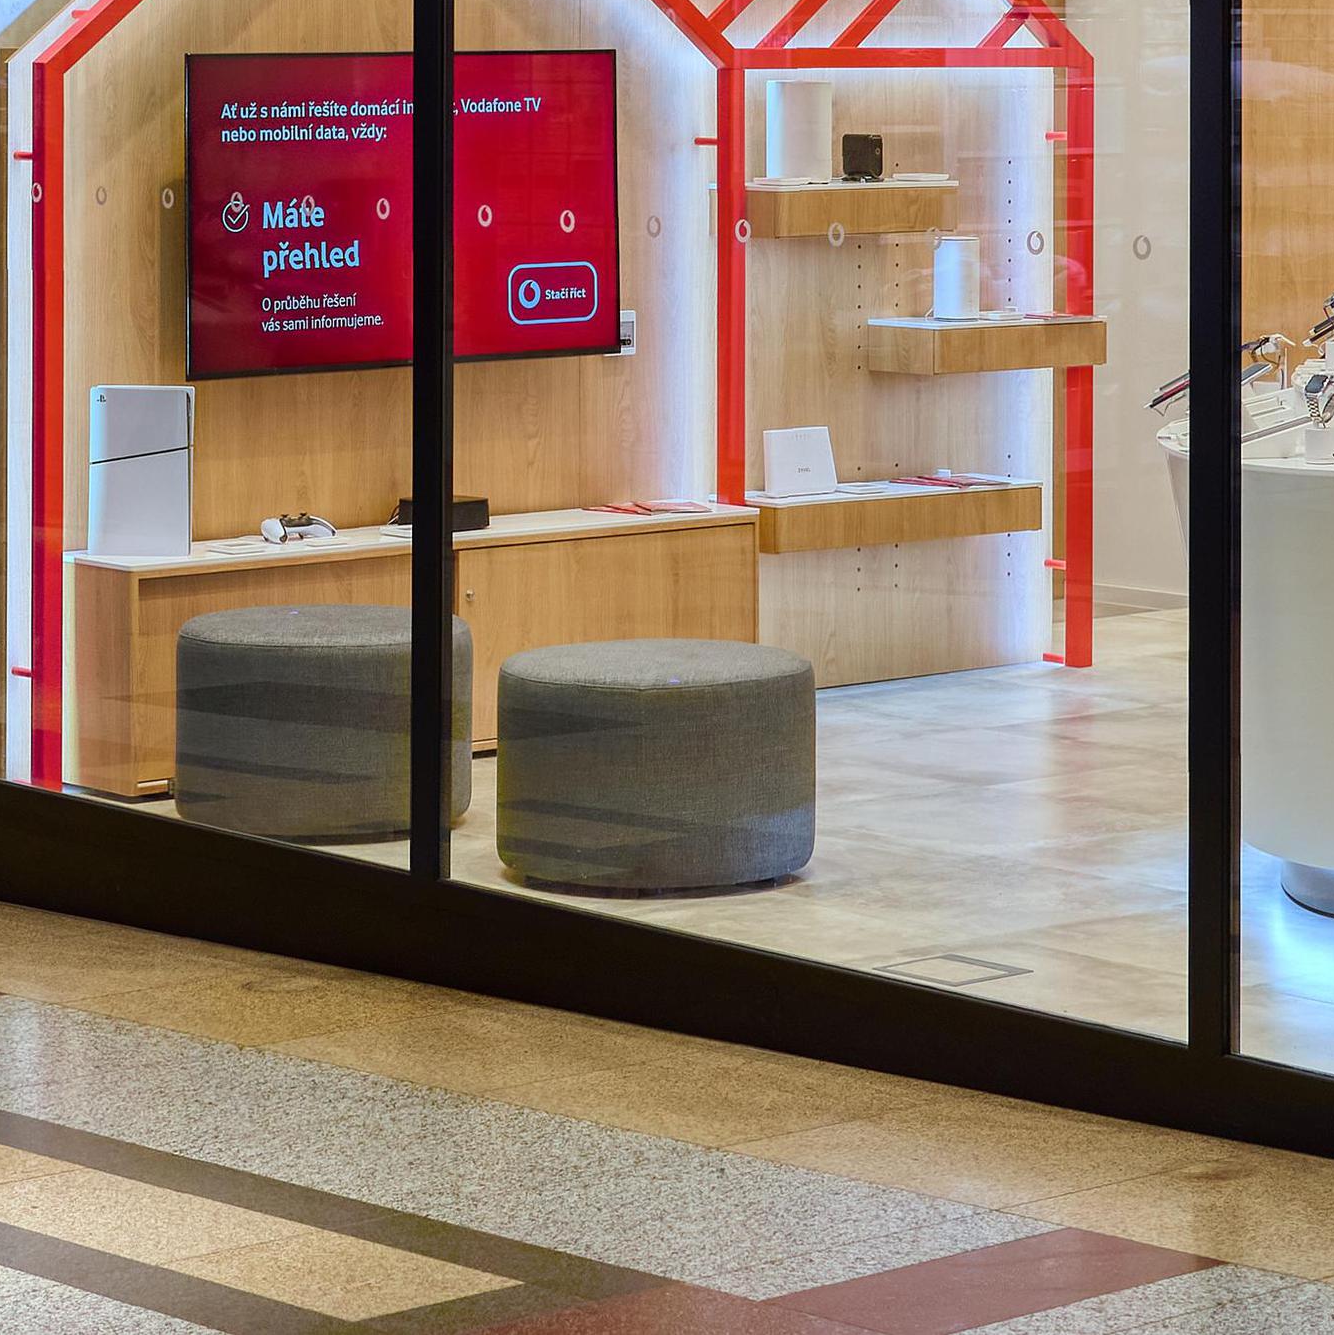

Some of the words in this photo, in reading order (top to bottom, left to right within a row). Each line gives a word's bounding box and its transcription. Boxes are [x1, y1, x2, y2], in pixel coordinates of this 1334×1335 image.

[221, 102, 237, 119] Ať
[240, 102, 257, 119] už
[260, 106, 268, 118] s
[271, 101, 306, 118] námi
[308, 100, 348, 118] řešíte
[350, 99, 401, 116] domácí
[460, 97, 522, 113] Vodafone
[523, 97, 542, 112] TV
[221, 126, 257, 142] nebo
[259, 124, 312, 141] mobilní
[315, 124, 349, 142] data,
[351, 122, 387, 143] vždy:
[263, 198, 325, 229] Máte
[263, 240, 360, 278] přehled
[262, 298, 272, 312] O
[274, 295, 320, 313] průběhu
[322, 292, 357, 308] řešení
[545, 287, 569, 300] Stačí
[570, 287, 586, 299] říct
[262, 316, 280, 332] vás
[282, 314, 309, 331] sami
[311, 312, 384, 330] informujeme.
